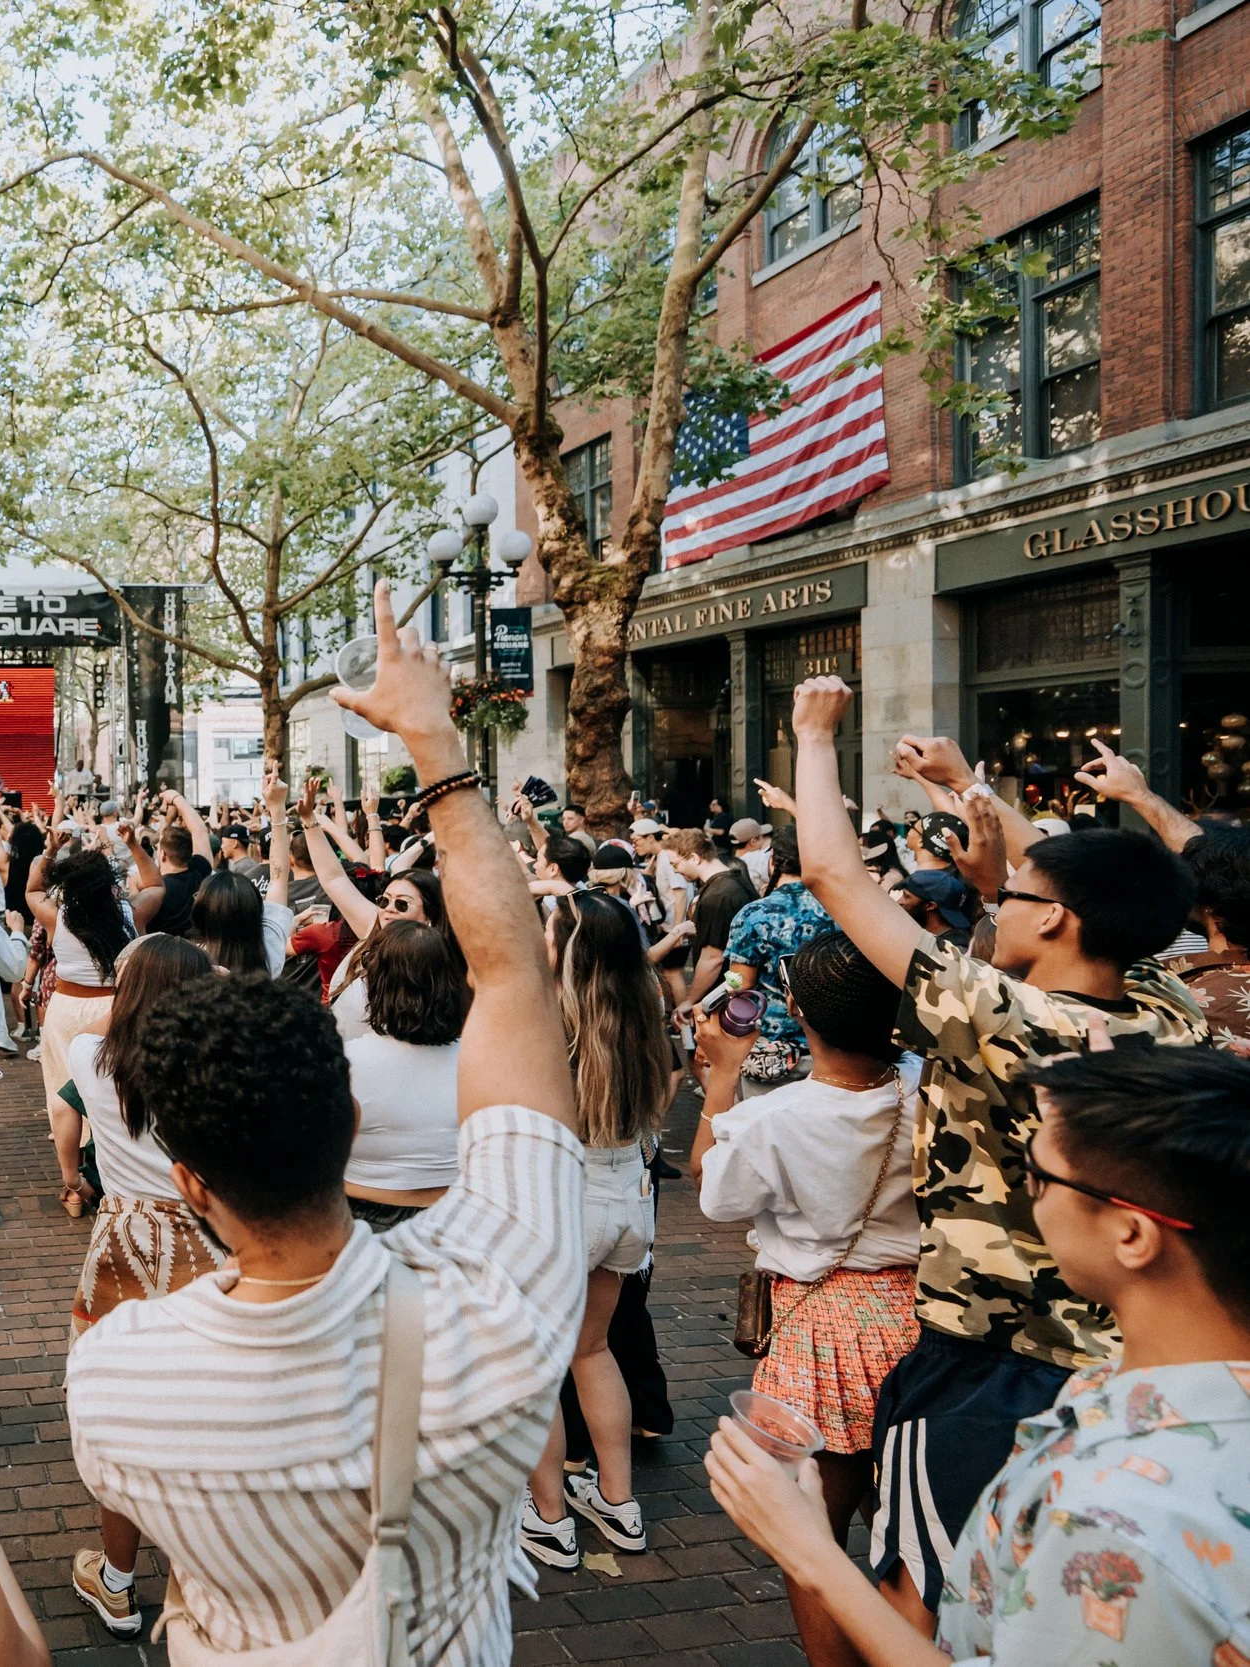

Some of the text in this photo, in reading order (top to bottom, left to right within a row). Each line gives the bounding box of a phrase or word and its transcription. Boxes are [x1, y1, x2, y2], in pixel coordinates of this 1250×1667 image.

[24, 595, 67, 614] TO
[694, 597, 751, 629] FINE
[760, 579, 832, 615] ARTS
[493, 624, 528, 642] Pioneer
[493, 641, 529, 650] SQUARE
